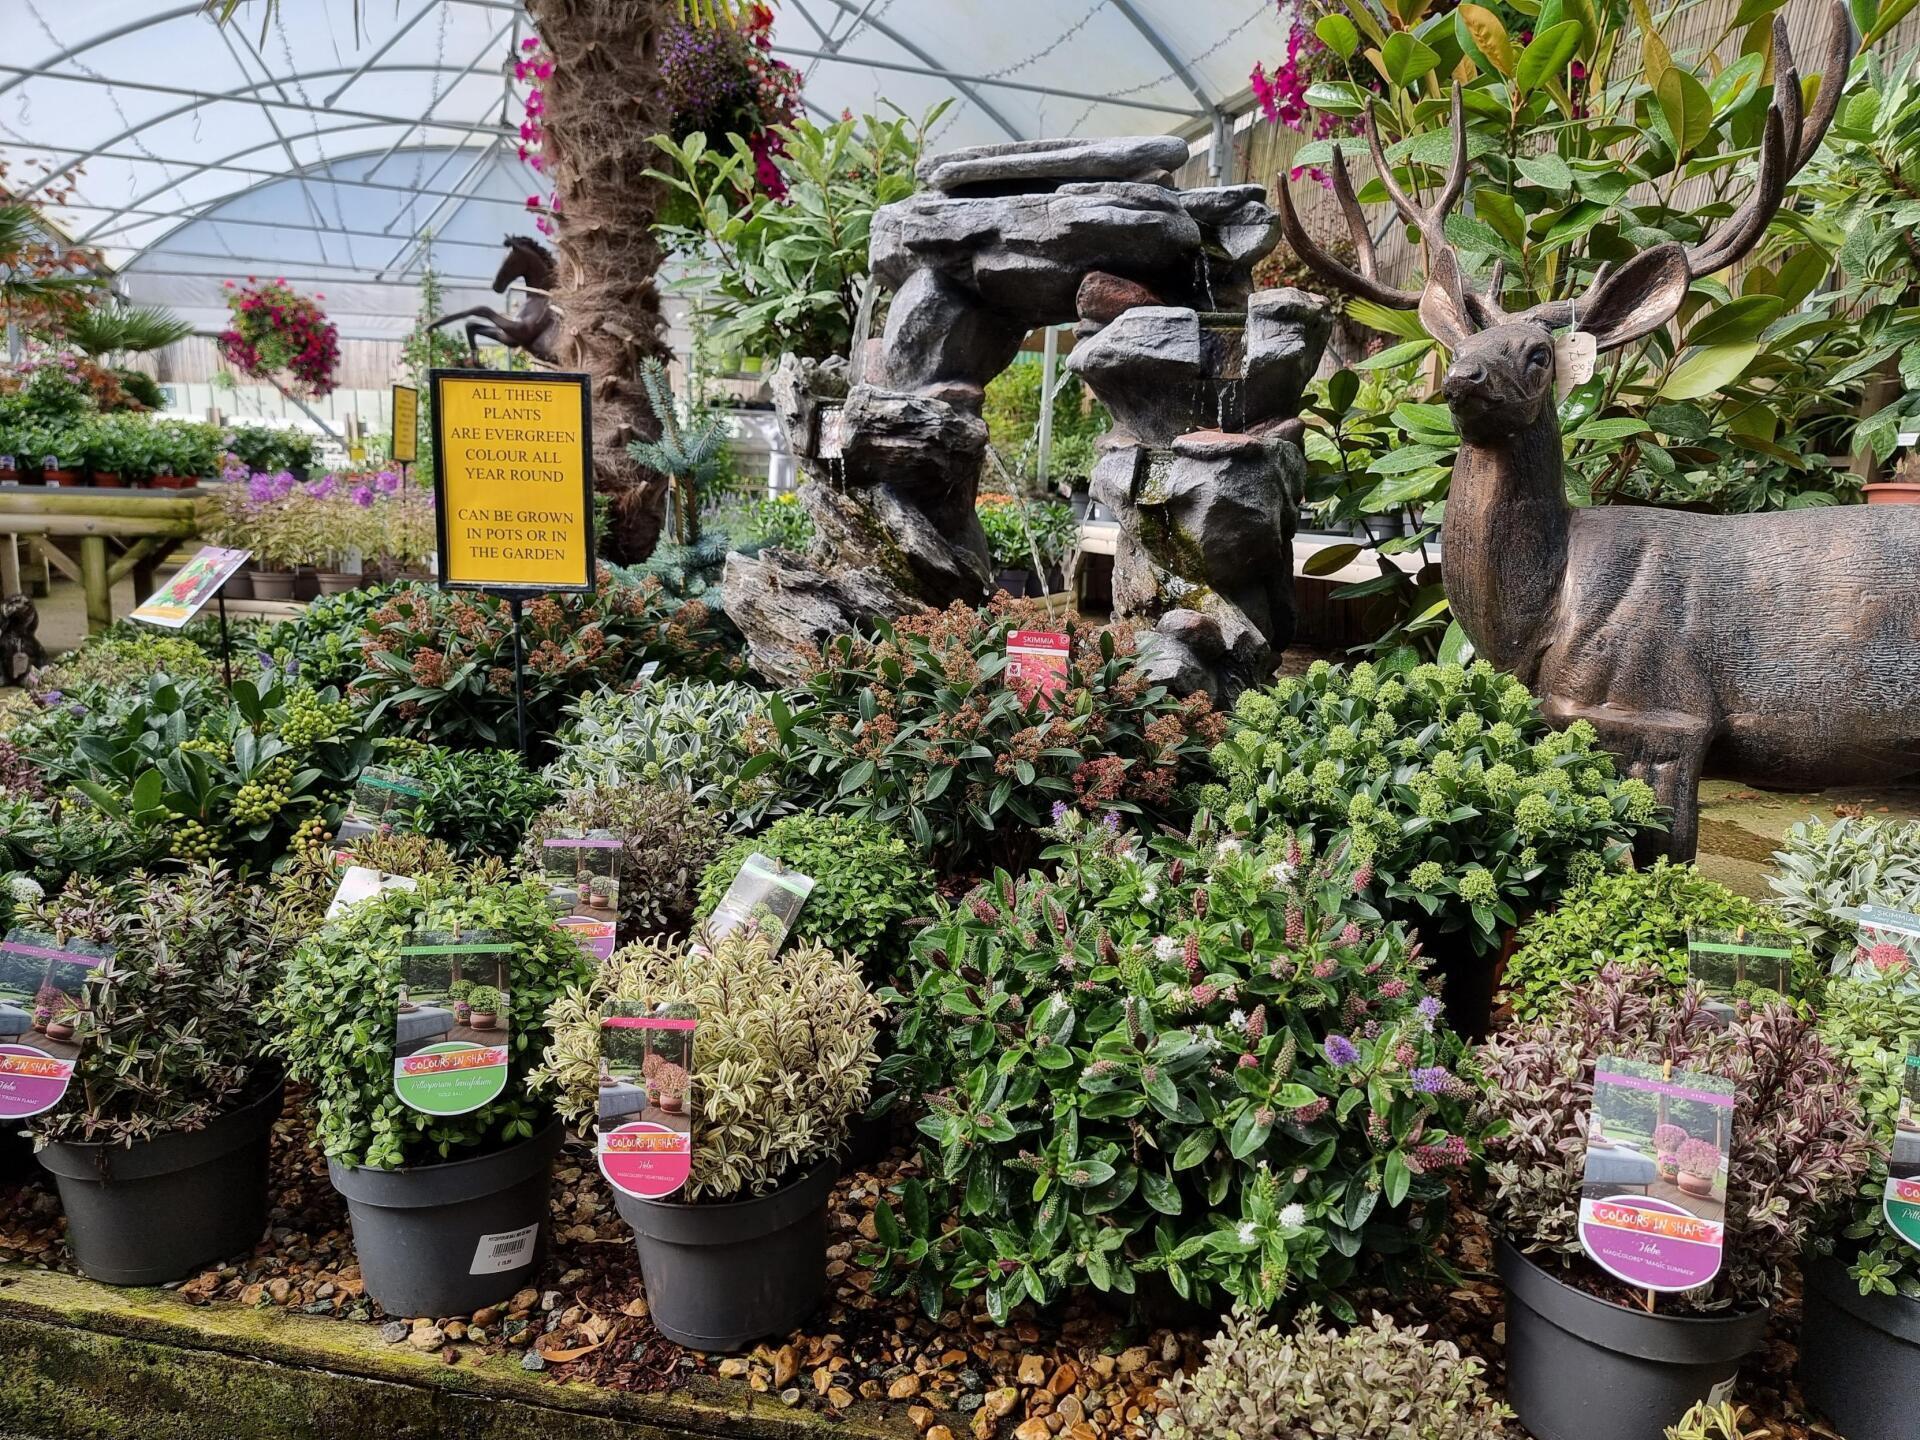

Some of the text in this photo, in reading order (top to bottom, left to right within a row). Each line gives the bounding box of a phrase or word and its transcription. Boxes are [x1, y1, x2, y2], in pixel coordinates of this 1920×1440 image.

[471, 388, 553, 402] ALL THESE
[483, 407, 541, 421] PLANTS
[451, 427, 575, 443] ARE EVERGREEN
[465, 449, 561, 464] COLOUR ALL
[465, 468, 564, 483] YEAR ROUND
[458, 509, 574, 524] CAN BE GROWN
[466, 528, 567, 541] IN POTS OR IN
[469, 547, 565, 560] THE GARDEN
[1023, 636, 1054, 645] SKIMMIA
[1877, 910, 1914, 922] SKIMMIA
[15, 1061, 29, 1070] IN
[31, 1062, 57, 1073] SHAPE
[410, 1052, 494, 1070] COLOURS IN SHAPE
[611, 1138, 680, 1149] COLOURS IN SHAPE
[1599, 1208, 1705, 1237] COLOURS IN SHAPE
[1639, 1241, 1662, 1256] Hebe
